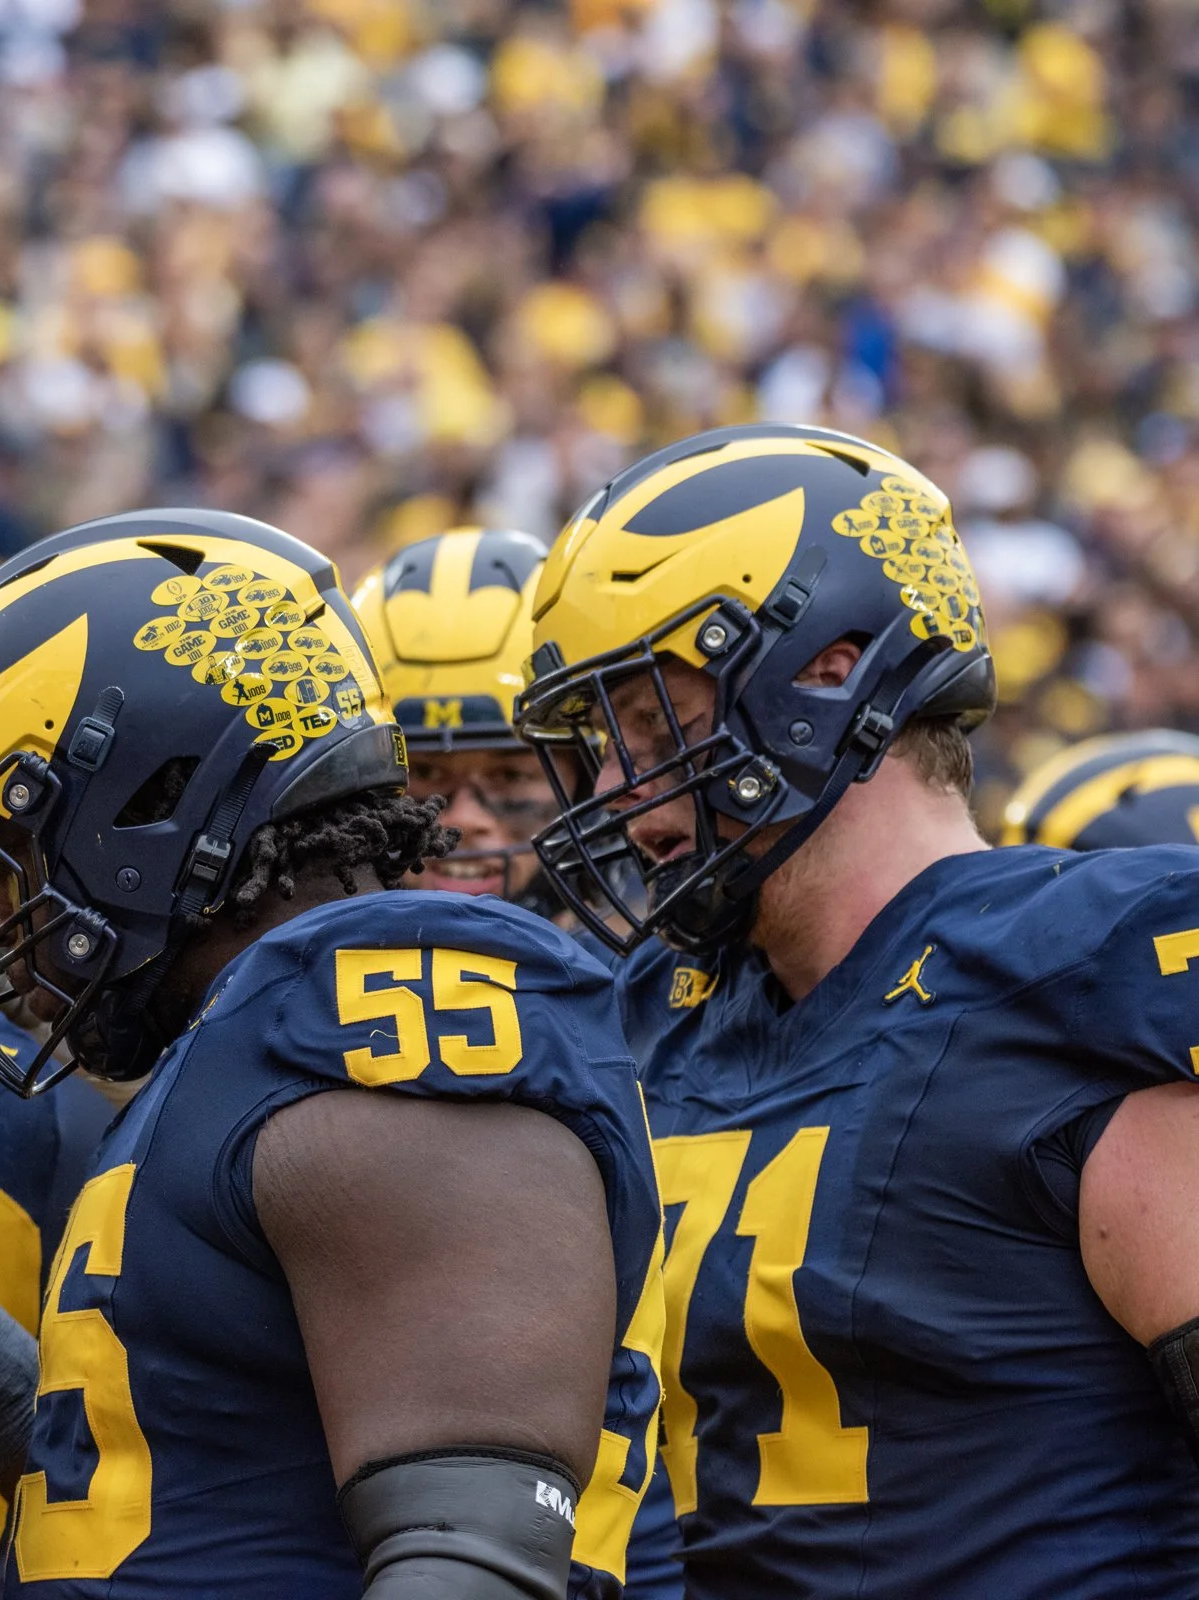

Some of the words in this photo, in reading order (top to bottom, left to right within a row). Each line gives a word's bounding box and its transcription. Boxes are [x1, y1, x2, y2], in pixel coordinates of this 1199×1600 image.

[164, 620, 182, 634] 1012
[218, 609, 250, 630] GAME
[231, 622, 249, 636] 1001
[173, 634, 206, 658] GAME
[260, 637, 279, 651] 1000
[187, 648, 203, 662] 1011
[248, 684, 267, 699] 1009
[337, 688, 362, 720] 55
[423, 699, 463, 729] M
[275, 712, 292, 723] 1008
[300, 711, 332, 731] TED
[334, 948, 523, 1087] 55
[651, 1125, 870, 1519] 71
[4, 1163, 153, 1583] 5
